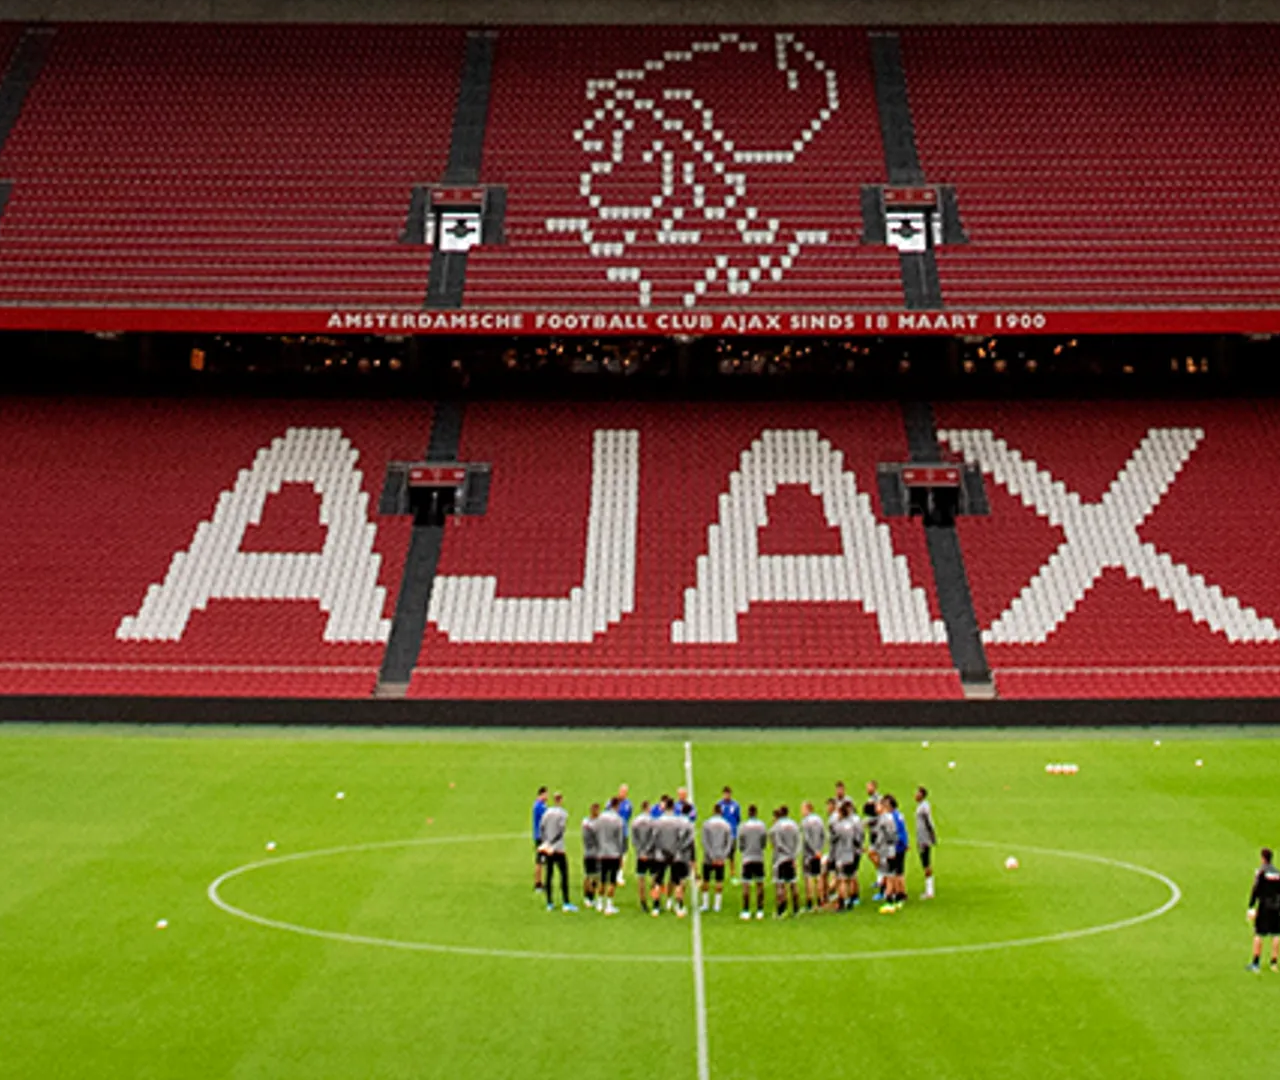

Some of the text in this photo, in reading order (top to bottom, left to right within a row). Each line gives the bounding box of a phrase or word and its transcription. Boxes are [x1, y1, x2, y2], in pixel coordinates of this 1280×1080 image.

[326, 312, 1047, 332] AMSTERDAMSCHE FOOTBALL CLUB AJAX SINDS 18 MAART 1900
